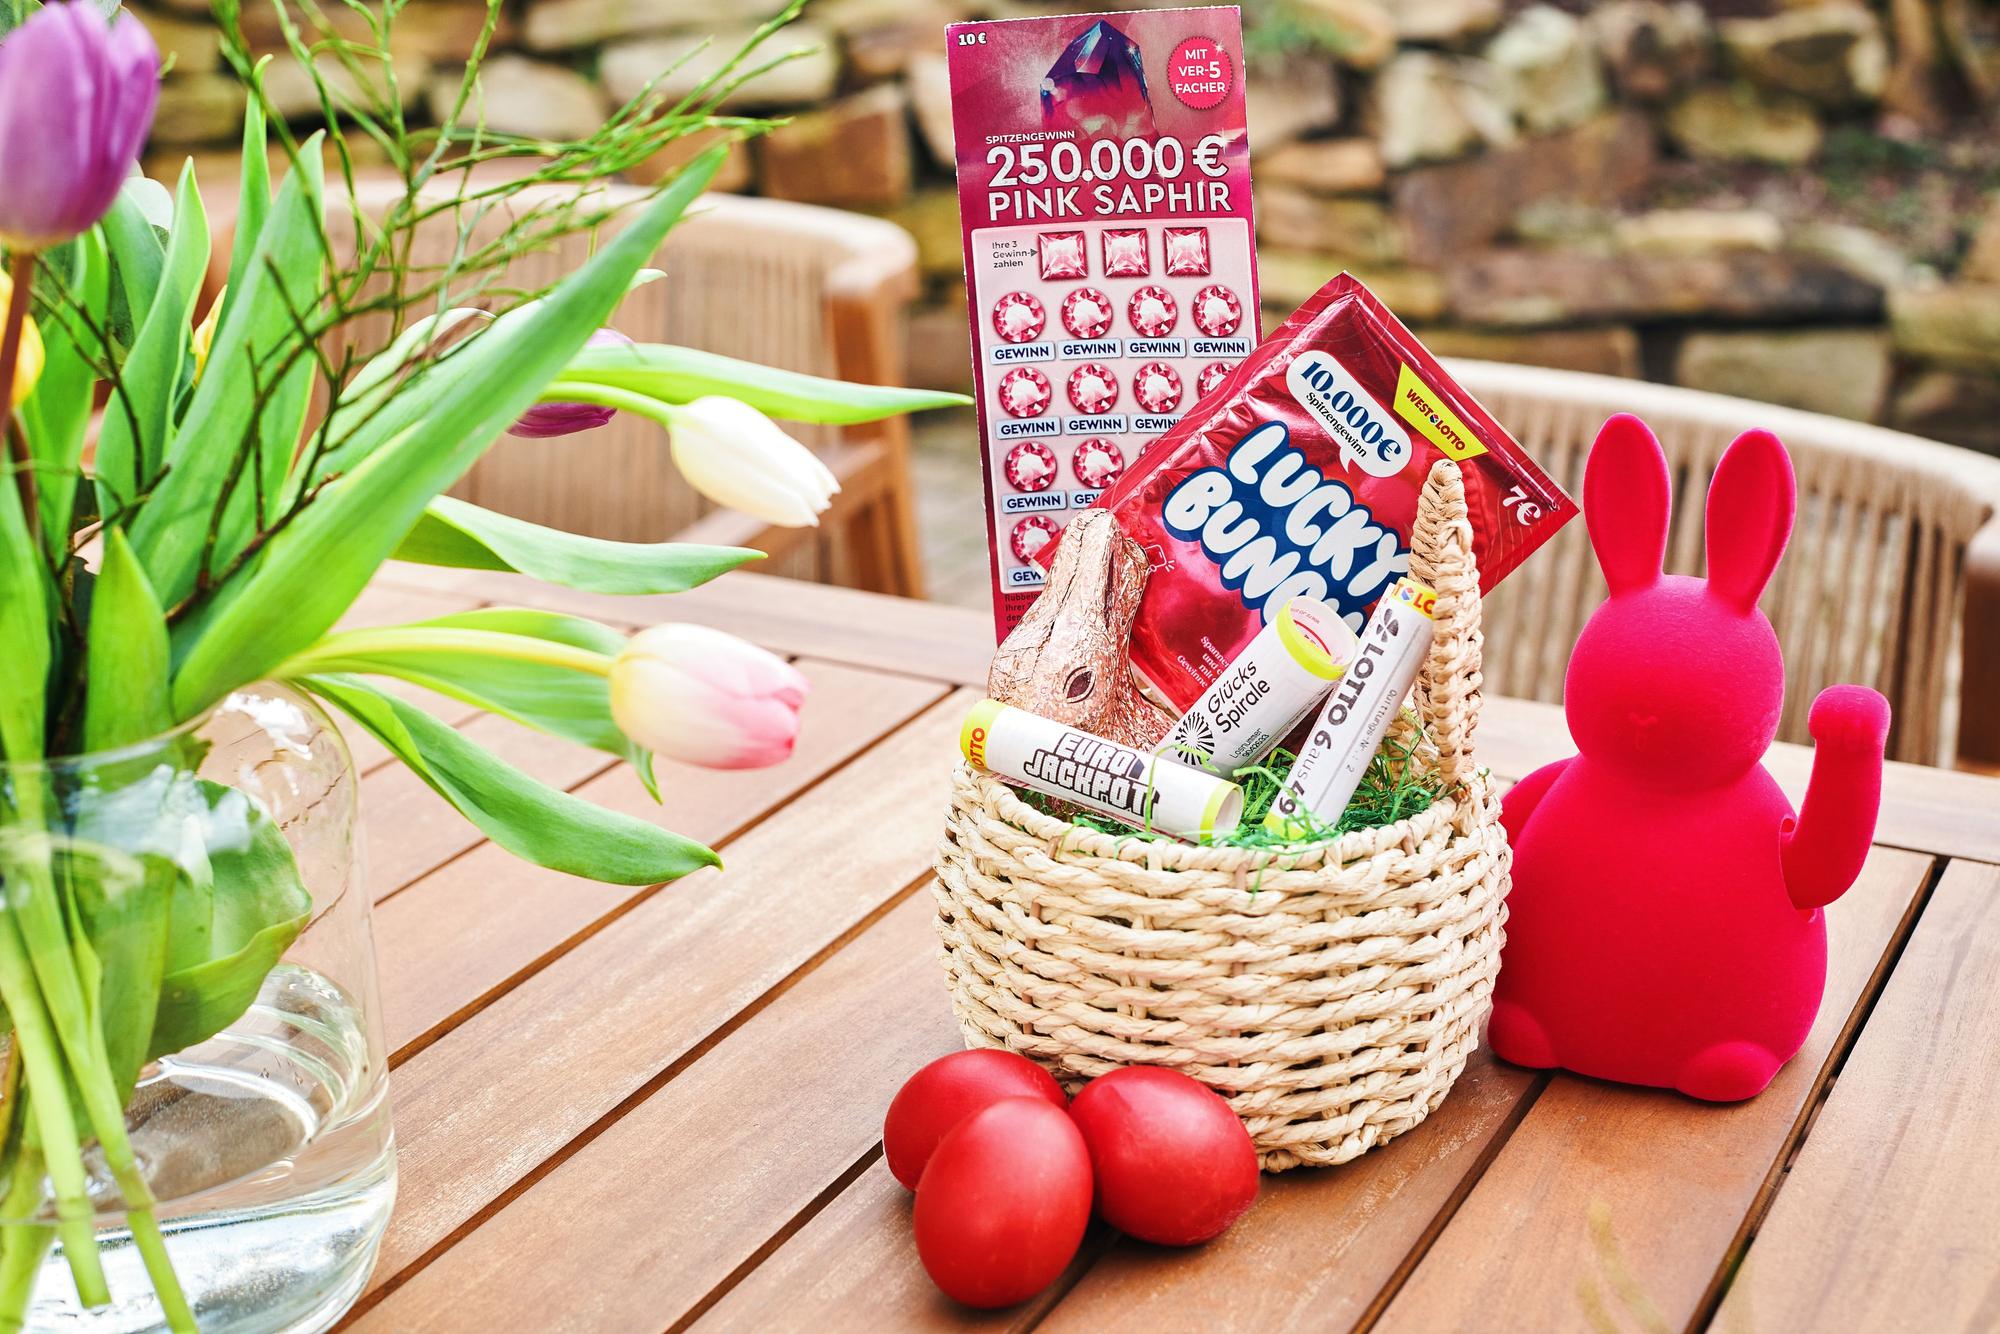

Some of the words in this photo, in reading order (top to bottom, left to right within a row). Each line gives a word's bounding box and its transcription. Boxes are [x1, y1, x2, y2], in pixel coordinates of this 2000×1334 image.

[958, 34, 976, 45] 10
[977, 32, 987, 44] €
[1185, 49, 1208, 60] MIT
[1175, 81, 1225, 94] FACHER
[985, 130, 1075, 145] SPITZENGEWINN
[986, 136, 1184, 188] 250.000
[1192, 135, 1229, 178] €
[988, 187, 1084, 221] PINK
[1094, 181, 1233, 215] SAPHIR
[992, 241, 1010, 250] Ihre
[1012, 240, 1018, 248] 3
[993, 260, 1024, 268] zahlen
[995, 346, 1049, 360] GEWINN
[1063, 343, 1117, 355] GEWINN
[1130, 342, 1181, 353] GEWINN
[1193, 342, 1245, 353] GEWINN
[1000, 421, 1055, 435] GEWINN
[1069, 418, 1122, 431] GEWINN
[1135, 418, 1180, 429] GEWIN
[1306, 391, 1367, 458] Spitzengewinn
[1007, 495, 1061, 509] GEWINN
[1502, 485, 1541, 526] 7€
[1229, 424, 1410, 597] LUCKY
[1164, 470, 1365, 633] BUNC
[1202, 653, 1218, 669] und
[1177, 655, 1208, 688] Gewinne
[1199, 664, 1214, 678] mit
[1208, 661, 1257, 714] Glücks
[1328, 643, 1384, 726] LOTTO
[1215, 680, 1271, 733] Spirale
[970, 728, 985, 767] OTTO
[1053, 732, 1140, 779] EURO
[1024, 749, 1159, 819] JACKPOT
